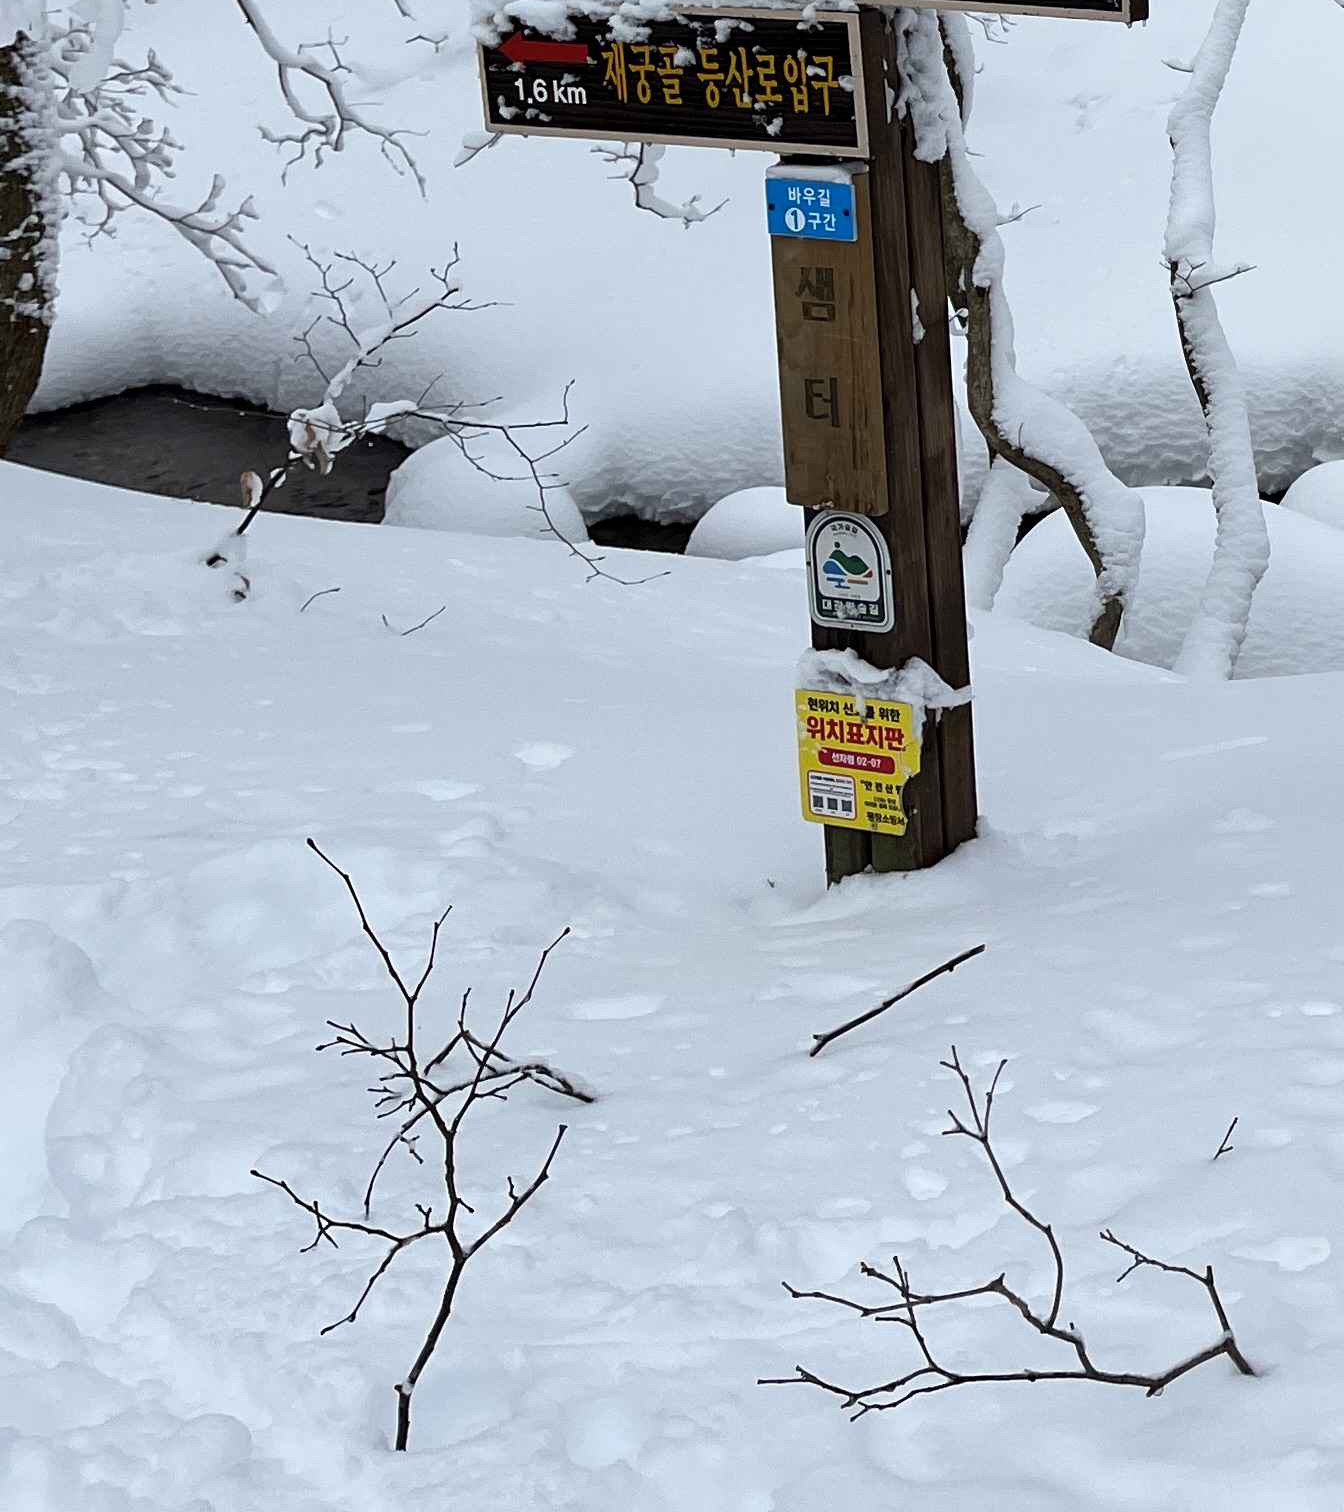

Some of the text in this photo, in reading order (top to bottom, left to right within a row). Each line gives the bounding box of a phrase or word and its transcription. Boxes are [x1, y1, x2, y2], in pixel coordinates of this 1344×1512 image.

[514, 77, 587, 106] 1.6 km
[602, 42, 841, 117] 재궁골 등산로입구
[787, 186, 832, 208] 바우길
[807, 696, 840, 715] 현위치
[878, 707, 901, 723] 위한
[806, 715, 906, 752] 위치표지판
